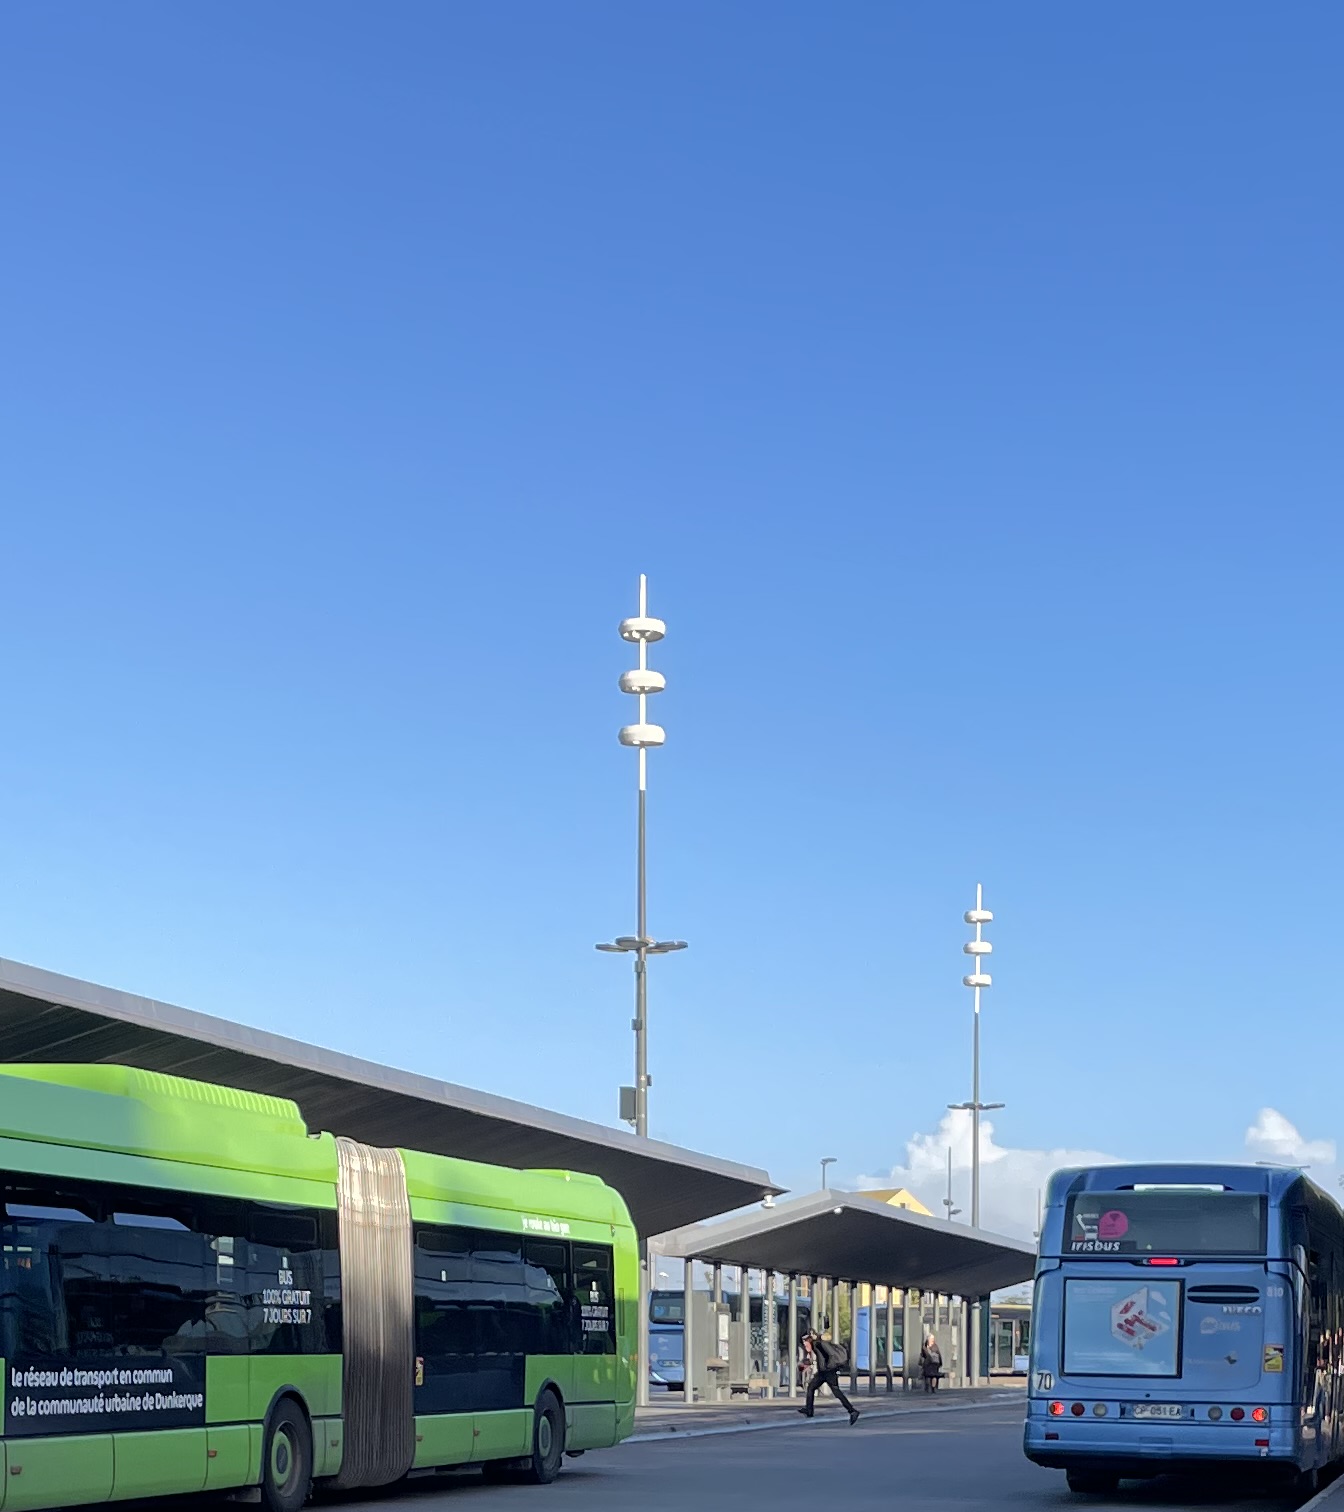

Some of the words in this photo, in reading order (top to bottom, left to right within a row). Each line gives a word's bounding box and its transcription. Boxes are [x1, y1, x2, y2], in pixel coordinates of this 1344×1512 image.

[278, 1269, 293, 1285] BUS
[11, 1366, 22, 1387] le
[23, 1366, 58, 1387] réseau
[59, 1366, 72, 1387] de
[73, 1367, 118, 1389] transport
[119, 1370, 132, 1384] en
[132, 1369, 173, 1384] commun
[1037, 1372, 1053, 1391] 70
[11, 1396, 25, 1417] de
[26, 1396, 37, 1416] la
[38, 1392, 104, 1416] communauté
[105, 1392, 141, 1413] urbaine
[142, 1391, 154, 1411] de
[155, 1391, 203, 1411] Dunkerque
